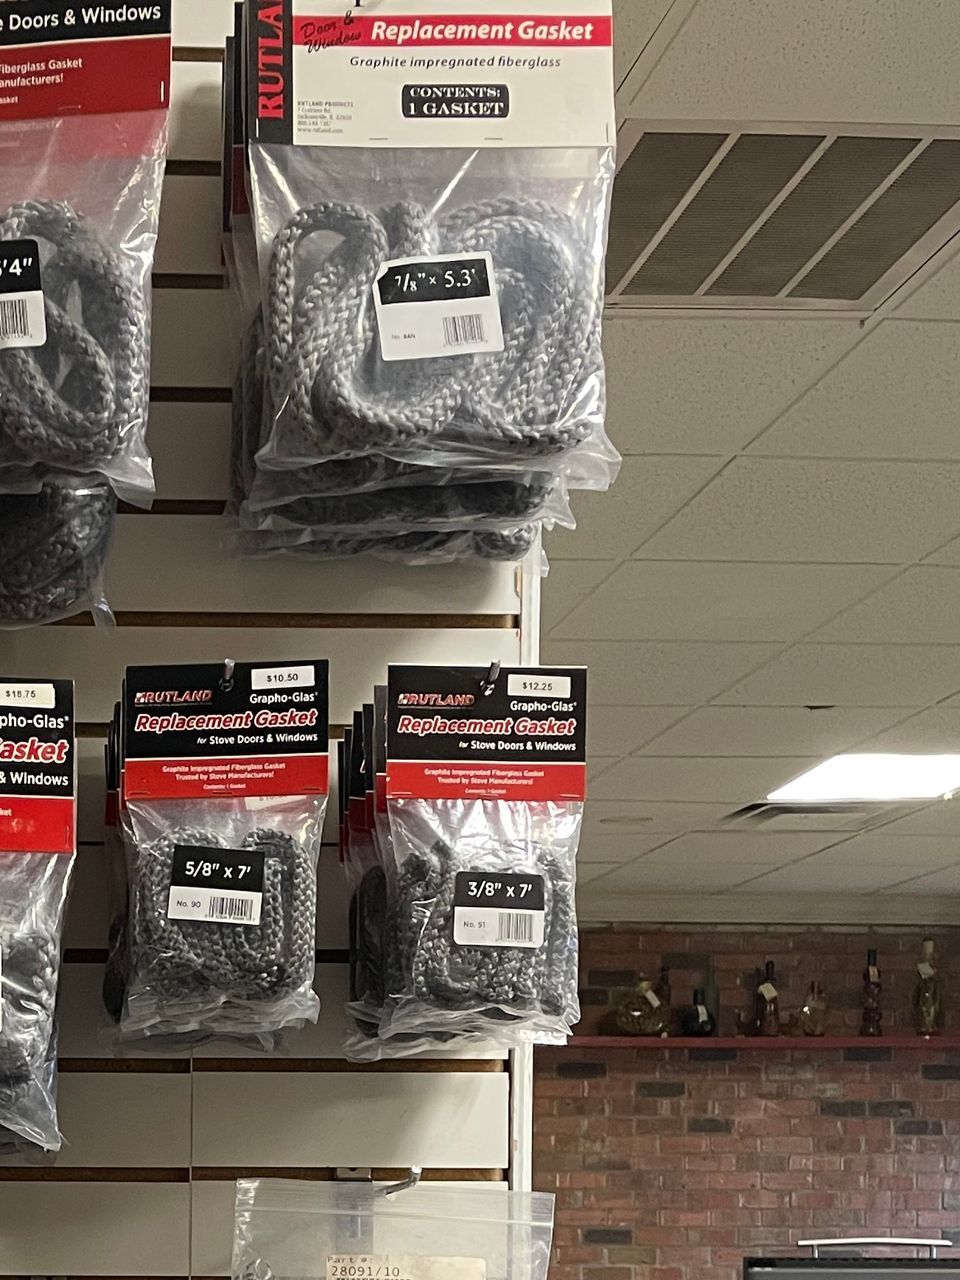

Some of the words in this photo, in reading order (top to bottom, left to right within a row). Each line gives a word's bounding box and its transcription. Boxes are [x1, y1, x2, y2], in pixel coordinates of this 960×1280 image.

[9, 14, 60, 30] Doors
[64, 10, 76, 25] &
[81, 4, 162, 25] Windows
[371, 20, 513, 41] Replacement
[518, 20, 594, 41] Gasket
[48, 57, 83, 71] Gasket
[258, 0, 284, 119] RUTLA
[350, 55, 407, 70] Graphite
[409, 55, 495, 70] impregnated
[498, 55, 562, 69] fiberglass
[410, 86, 501, 99] CONTENTS:
[408, 103, 415, 115] 1
[424, 102, 504, 115] GASKET
[444, 269, 476, 289] 5.3'
[267, 673, 299, 682] $10.50
[522, 681, 553, 692] $12.25
[5, 690, 36, 699] $18.75
[144, 690, 213, 703] RUTLAND
[408, 694, 475, 706] RUTLAND
[134, 711, 252, 735] Replacement
[254, 708, 318, 729] Gasket
[397, 715, 512, 737] Replacement
[514, 717, 577, 737] Gasket
[196, 737, 208, 745] for
[210, 735, 235, 745] Stove
[237, 734, 265, 744] Doors
[266, 734, 273, 743] &
[276, 733, 318, 742] Windows
[10, 771, 69, 786] Windows
[185, 861, 220, 877] 5/8"
[224, 867, 233, 878] x
[238, 865, 251, 879] 7'
[468, 881, 502, 897] 3/8"
[506, 886, 515, 897] x
[519, 884, 533, 898] 7'
[331, 1265, 400, 1277] 28091/10
